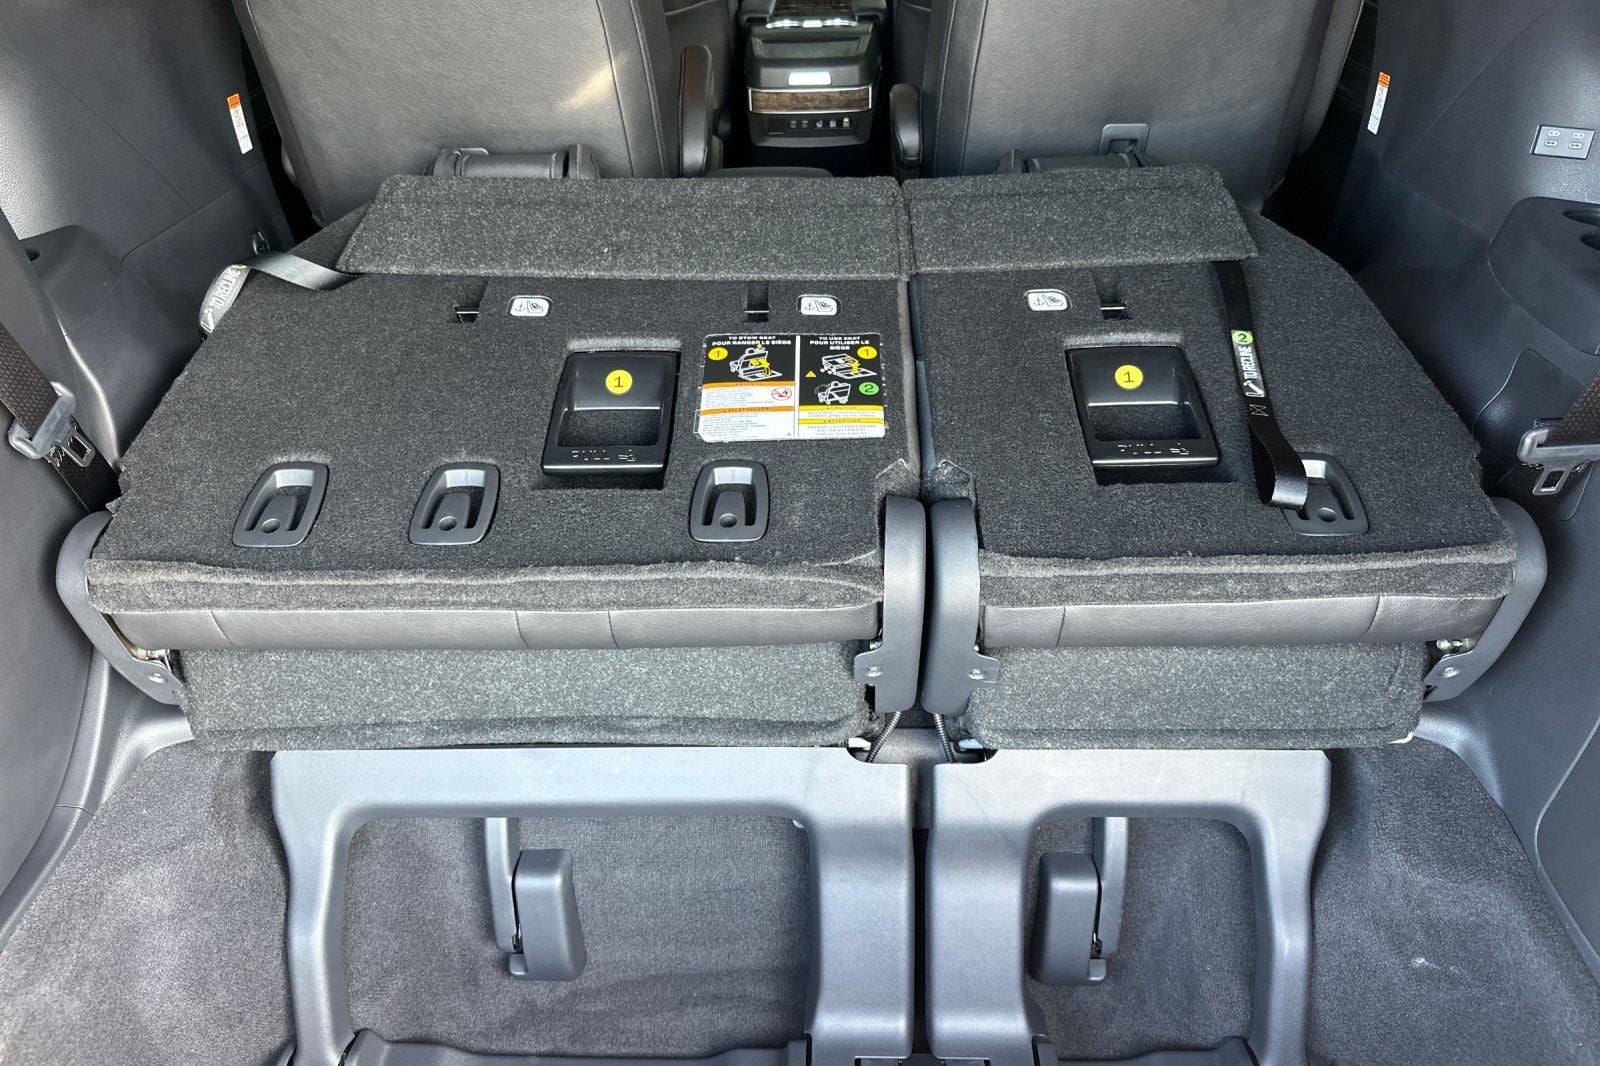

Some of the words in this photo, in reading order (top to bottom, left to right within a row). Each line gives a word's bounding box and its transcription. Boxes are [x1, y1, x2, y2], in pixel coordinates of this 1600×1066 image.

[214, 267, 241, 300] RECLINE
[209, 296, 225, 310] TO
[1237, 333, 1248, 343] 2
[1238, 345, 1257, 372] RECLINE
[613, 375, 624, 387] 1
[1123, 370, 1135, 383] 1
[1243, 371, 1258, 380] TO
[864, 383, 874, 393] 2
